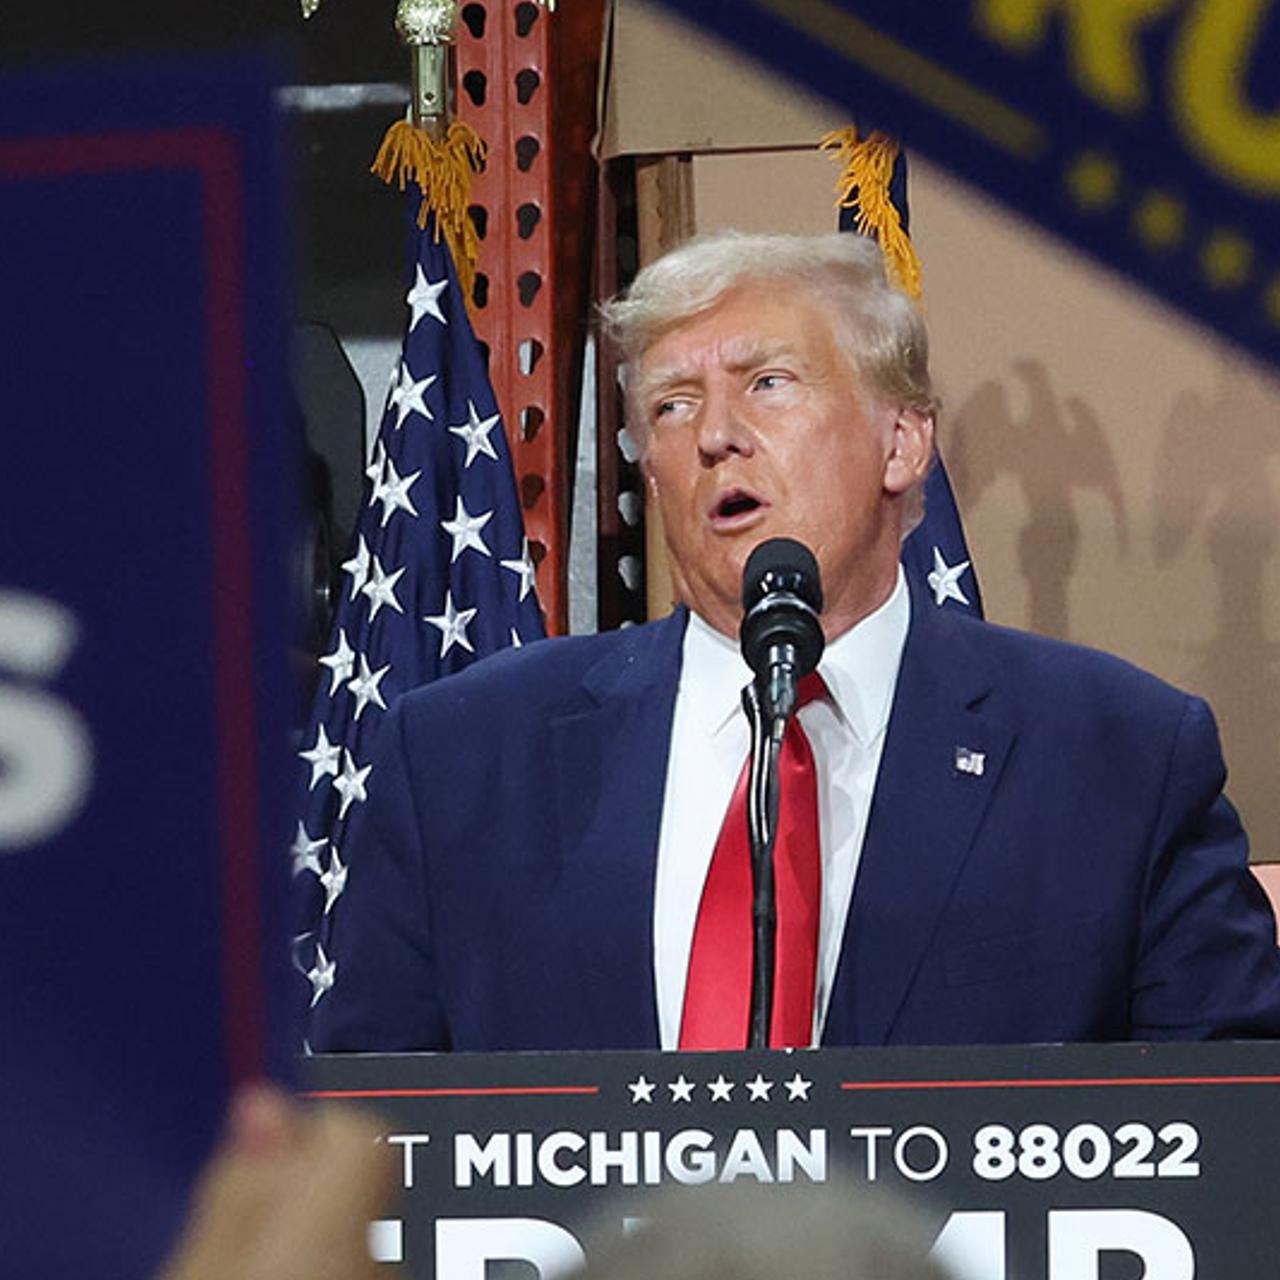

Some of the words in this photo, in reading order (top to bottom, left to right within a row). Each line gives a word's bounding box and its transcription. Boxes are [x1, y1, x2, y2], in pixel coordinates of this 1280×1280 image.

[453, 1128, 827, 1188] MICHIGAN
[850, 1125, 949, 1183] TO
[972, 1121, 1201, 1181] 88022
